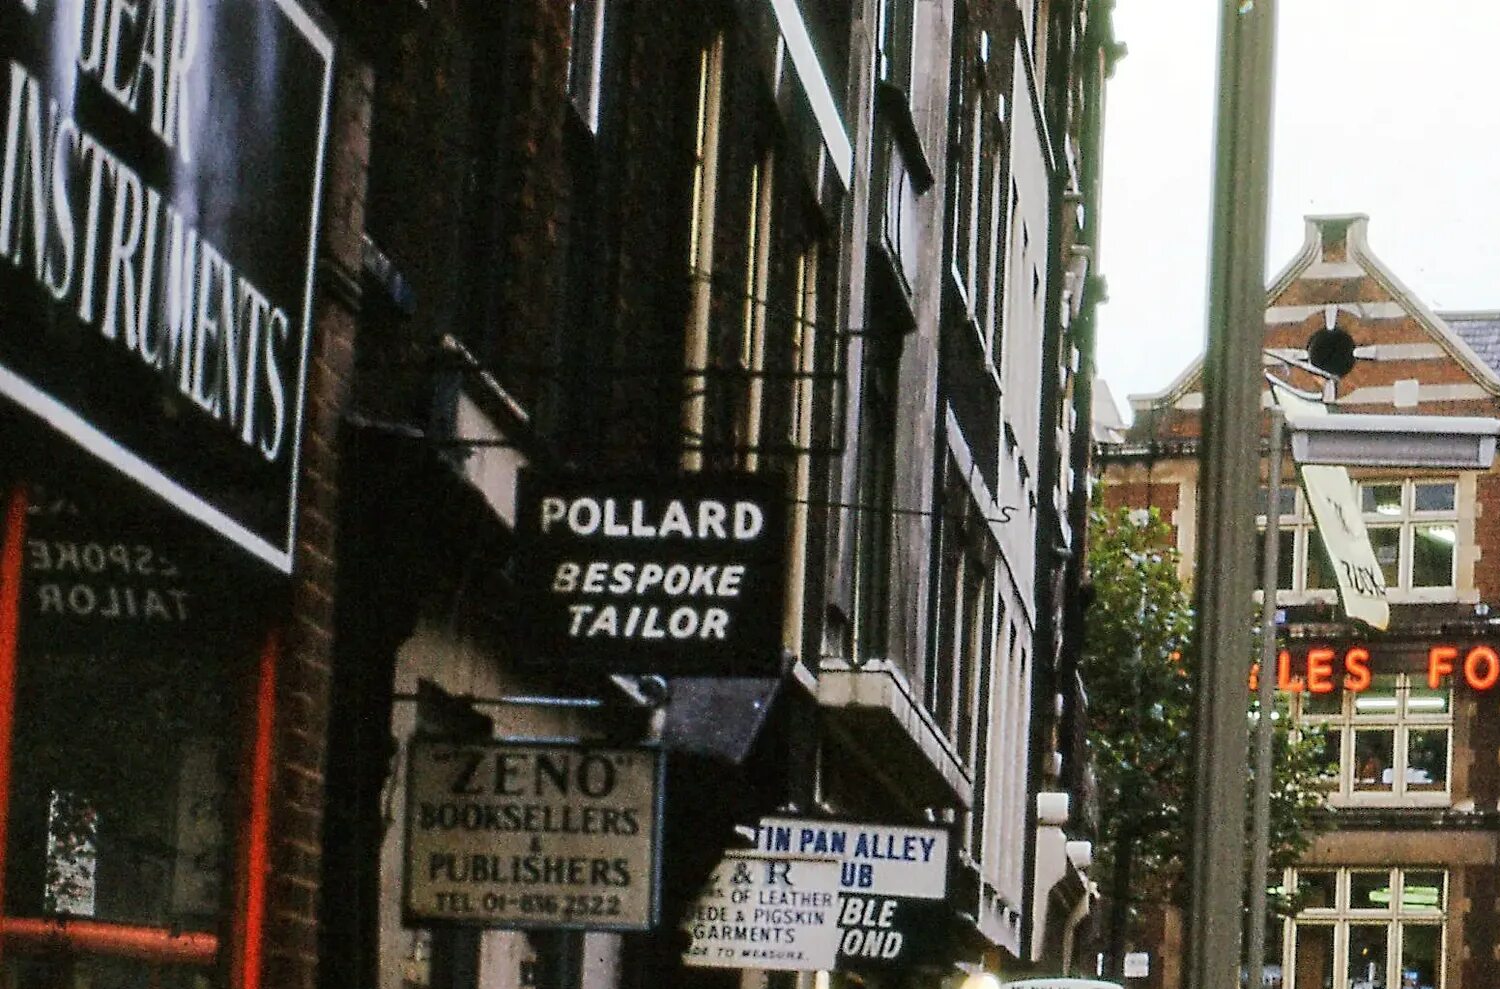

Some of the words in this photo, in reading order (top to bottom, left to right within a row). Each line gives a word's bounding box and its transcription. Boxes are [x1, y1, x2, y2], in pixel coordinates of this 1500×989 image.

[0, 62, 287, 460] INSTRUMENTS
[541, 497, 764, 540] POLLARD
[553, 561, 746, 597] BESPOKE
[568, 604, 730, 640] TAILOR
[1249, 646, 1371, 693] LES
[420, 802, 641, 836] BOOKSELLERS
[800, 828, 846, 853] PAN
[854, 833, 936, 862] ALLEY
[429, 851, 632, 887] PUBLISHERS
[841, 862, 873, 888] UB
[731, 889, 751, 904] OF
[759, 890, 833, 908] LEATHER
[842, 897, 898, 928] BLE
[698, 907, 727, 922] EDE
[754, 908, 825, 926] PIGSKIN
[693, 925, 796, 944] GARMENTS
[842, 929, 903, 958] OND
